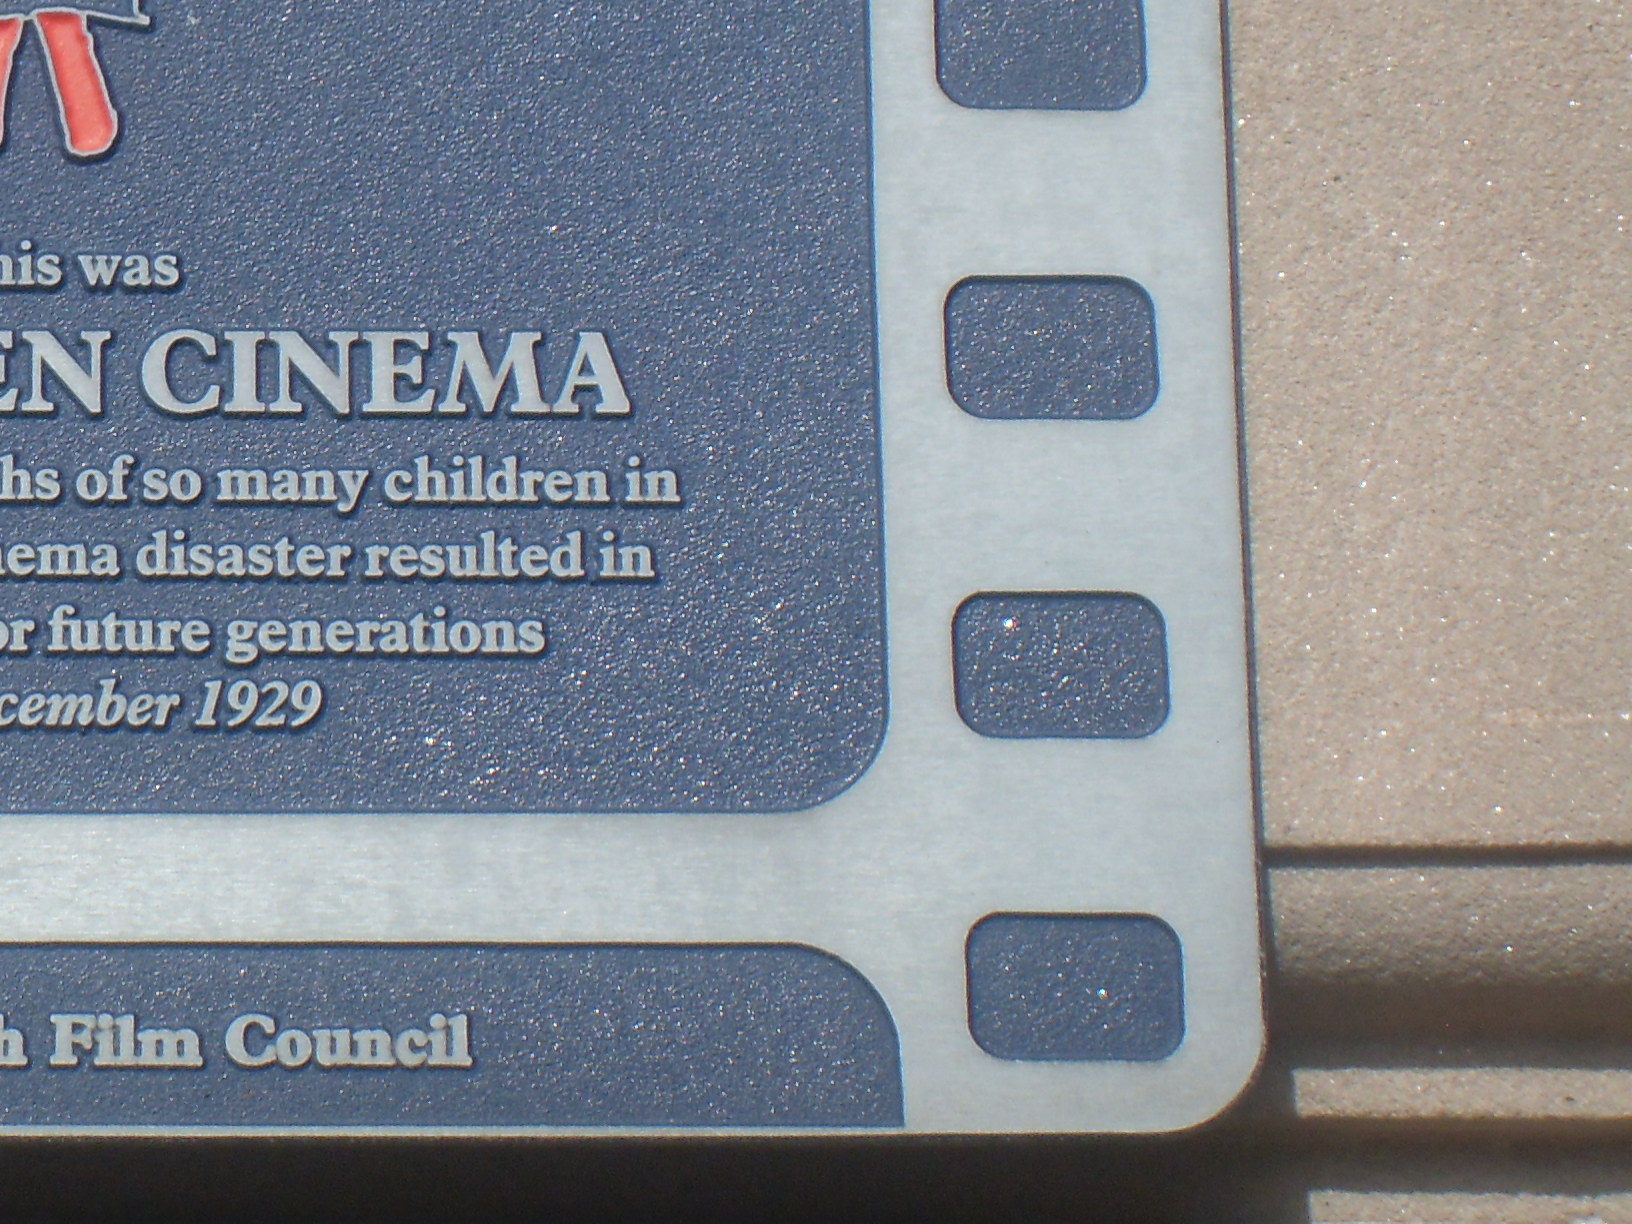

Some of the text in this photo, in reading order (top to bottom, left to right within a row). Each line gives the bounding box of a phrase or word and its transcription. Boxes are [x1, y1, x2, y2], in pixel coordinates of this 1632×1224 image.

[78, 251, 180, 287] was
[141, 329, 632, 414] CINEMA
[76, 454, 136, 503] of
[143, 466, 202, 503] so
[217, 466, 369, 514] many
[384, 455, 610, 504] children
[625, 455, 681, 504] in
[136, 529, 351, 577] disaster
[365, 530, 585, 578] resulted
[598, 531, 656, 579] in
[48, 604, 211, 654] future
[225, 606, 546, 664] generations
[194, 678, 323, 728] 1929
[49, 1013, 204, 1069] Film
[224, 1013, 474, 1070] Council
